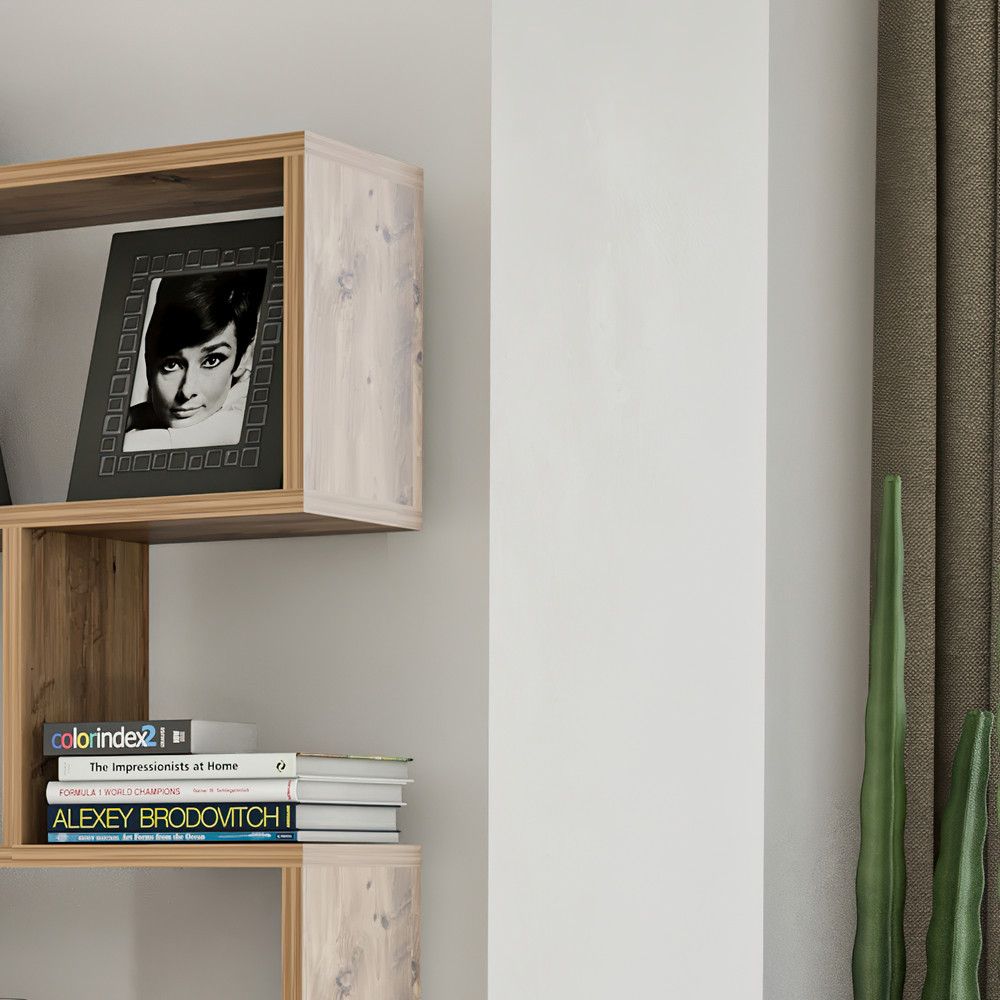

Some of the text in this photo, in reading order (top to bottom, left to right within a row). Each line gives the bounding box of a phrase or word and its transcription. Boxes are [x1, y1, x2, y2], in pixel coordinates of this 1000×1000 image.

[51, 724, 157, 750] colorindex2
[90, 760, 239, 774] The Impressionists at Home
[59, 787, 181, 797] FORMULA WORLD CHAMPIONS
[52, 807, 134, 829] ALEXEY
[140, 805, 279, 829] BRODOVITCH
[134, 833, 155, 841] Forms
[155, 833, 172, 841] from
